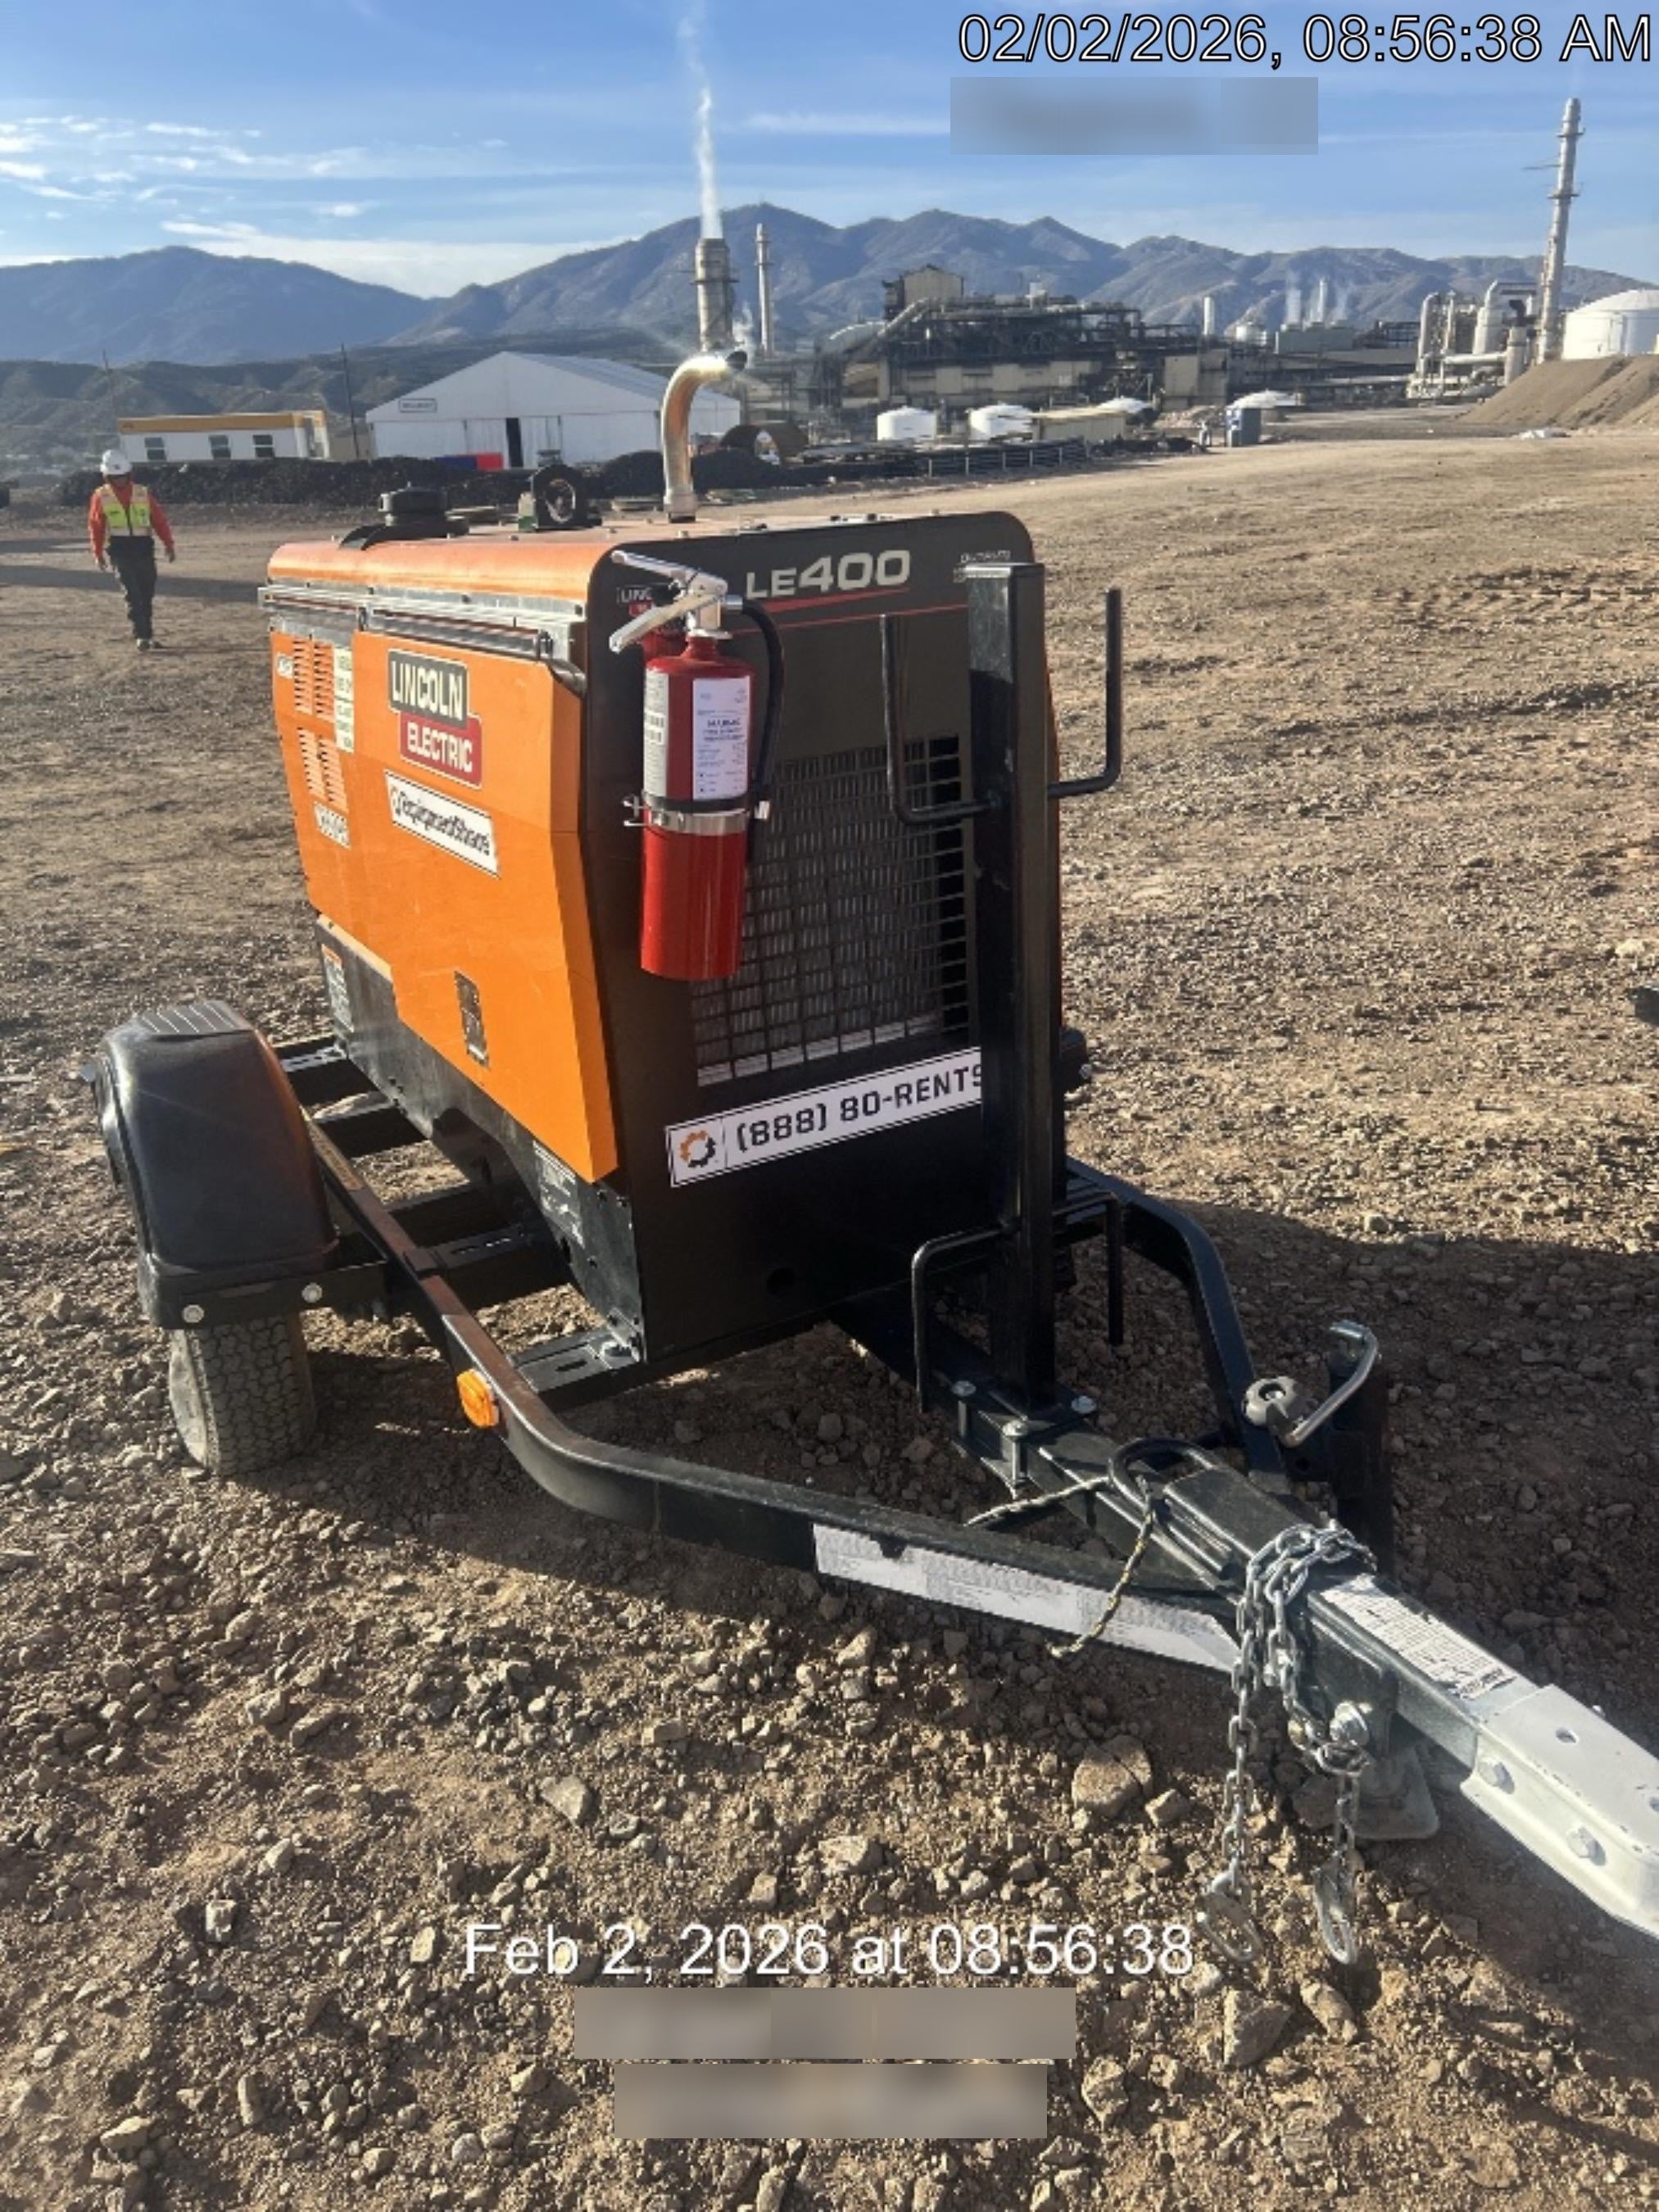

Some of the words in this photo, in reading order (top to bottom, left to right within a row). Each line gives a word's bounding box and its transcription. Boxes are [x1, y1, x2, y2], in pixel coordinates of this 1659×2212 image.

[746, 550, 910, 600] LE400
[392, 660, 463, 721] LINCOLN
[407, 722, 473, 773] ELECTRIC
[737, 1103, 827, 1153] (888)
